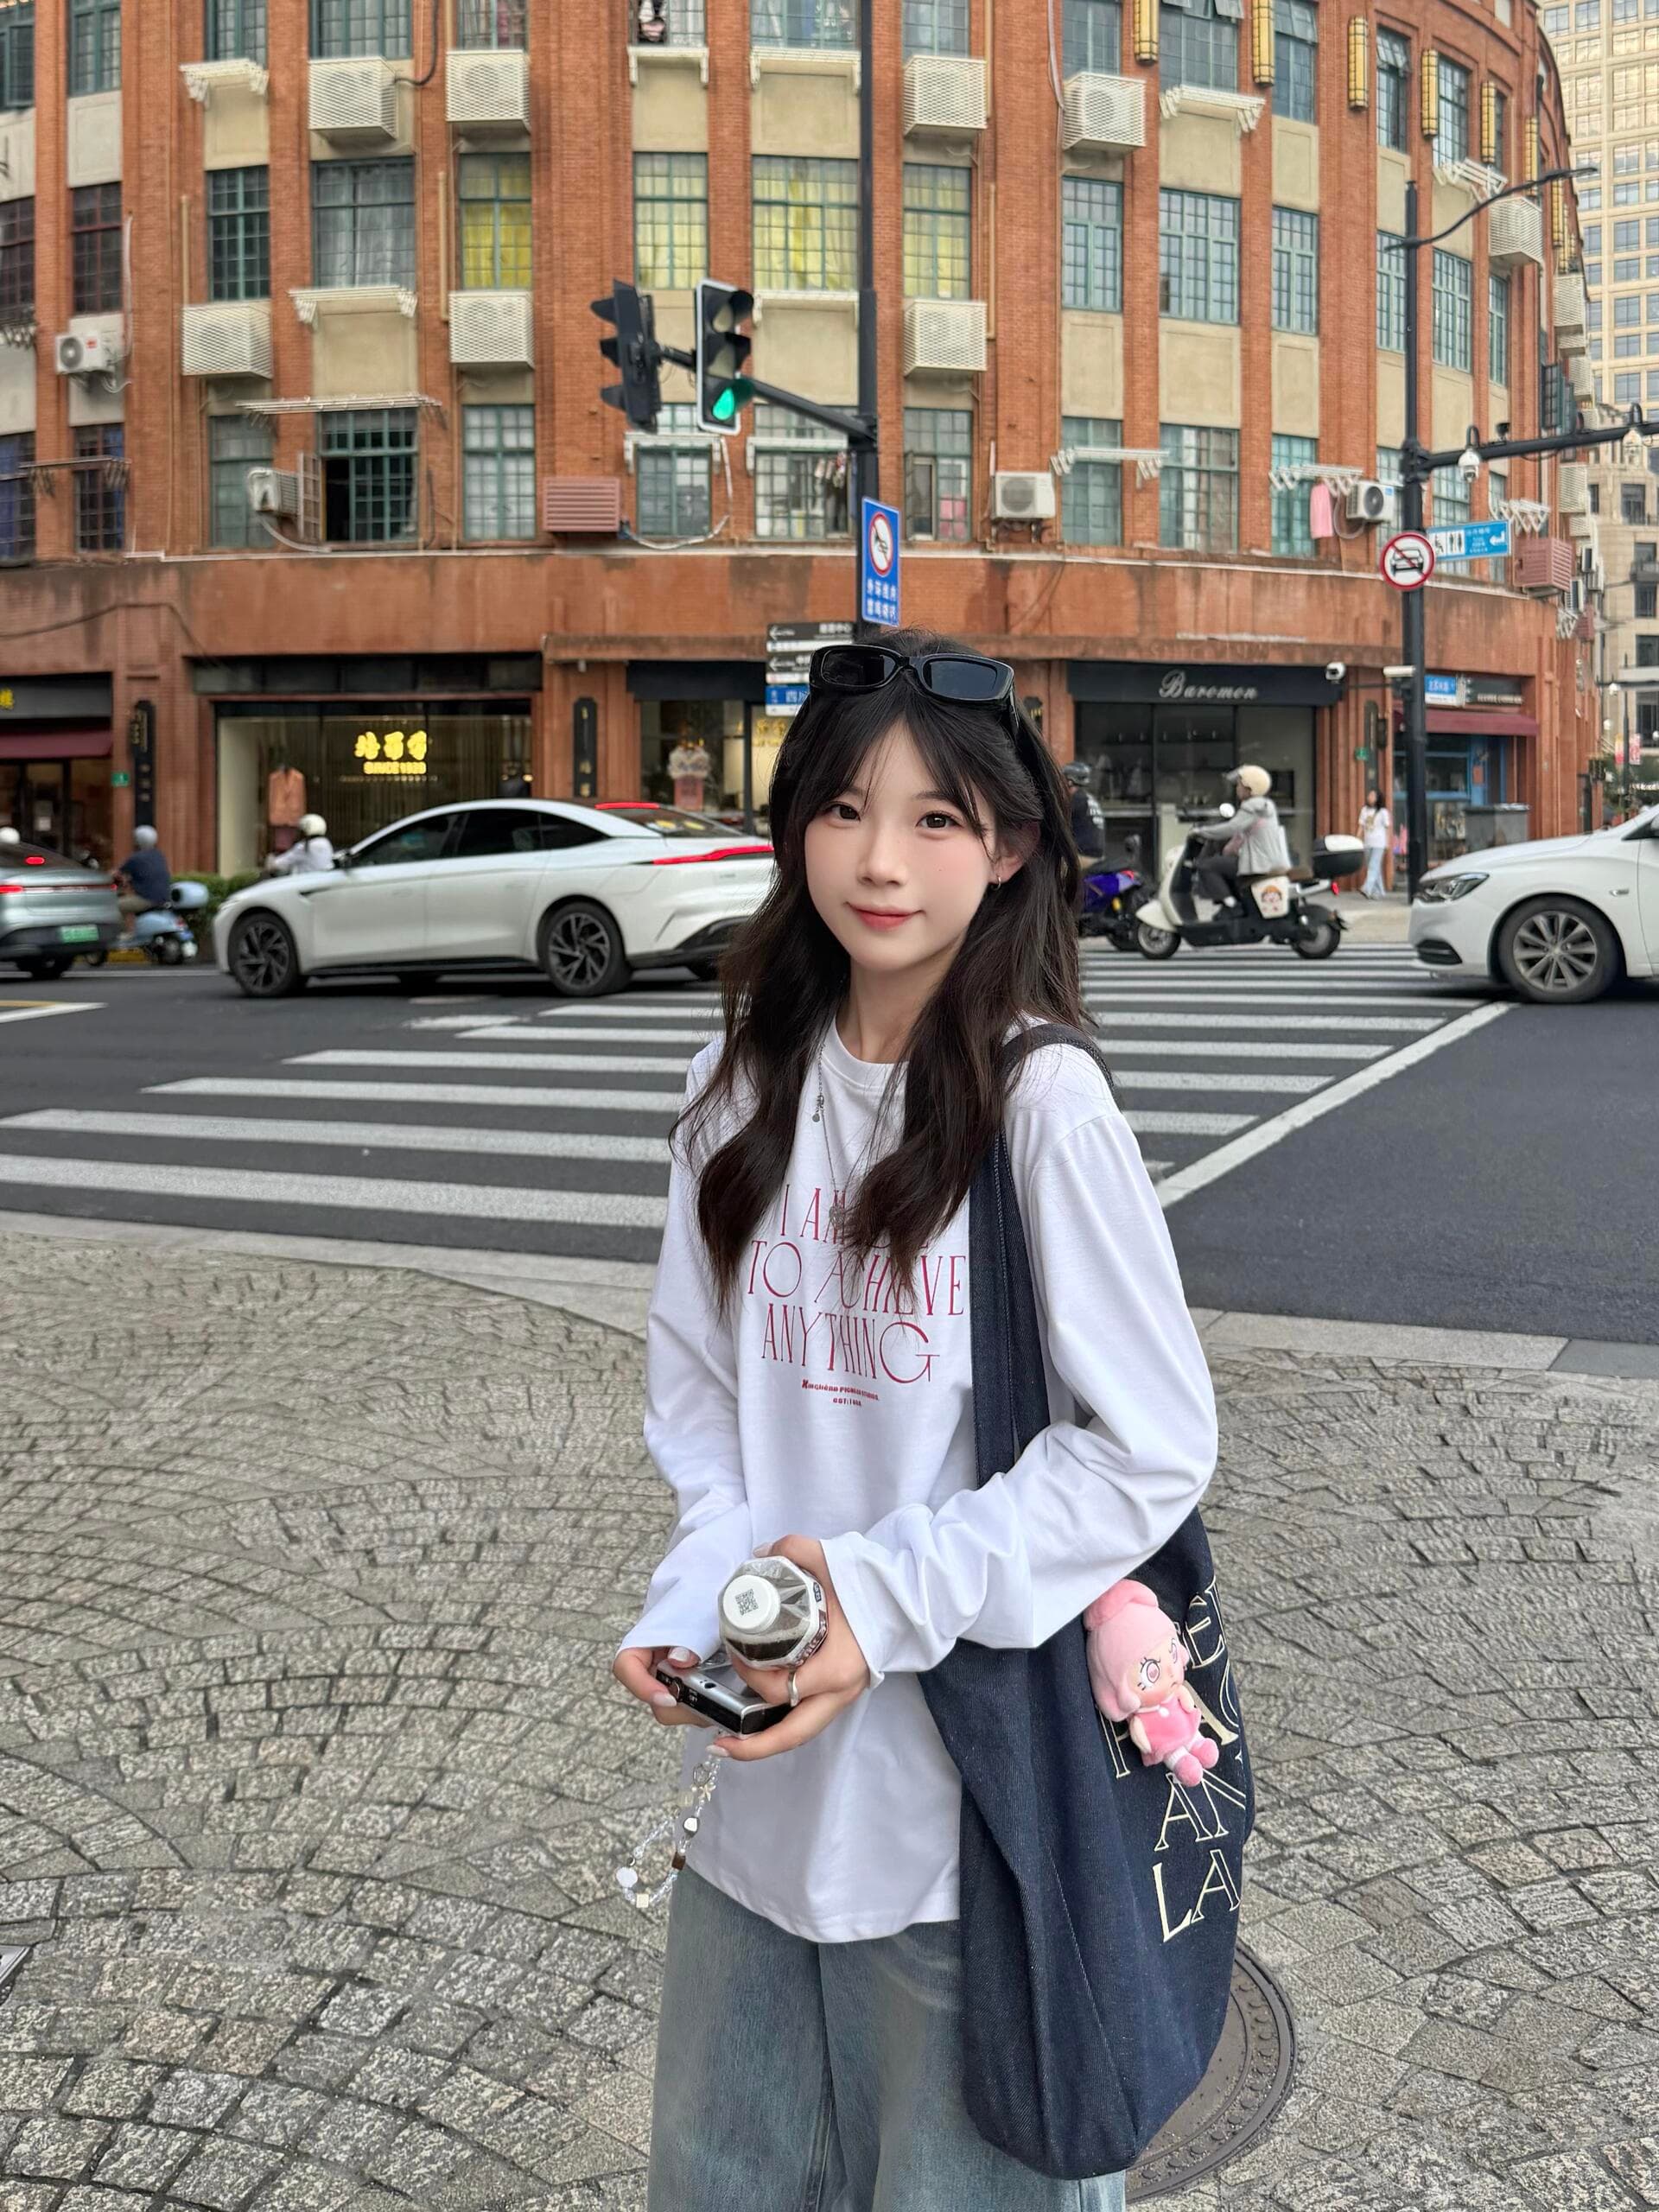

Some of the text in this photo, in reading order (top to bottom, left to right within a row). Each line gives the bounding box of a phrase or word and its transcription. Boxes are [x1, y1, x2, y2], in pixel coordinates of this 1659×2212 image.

[780, 1184, 790, 1236] I
[747, 1240, 803, 1298] TO
[761, 1303, 941, 1384] ANYTHING
